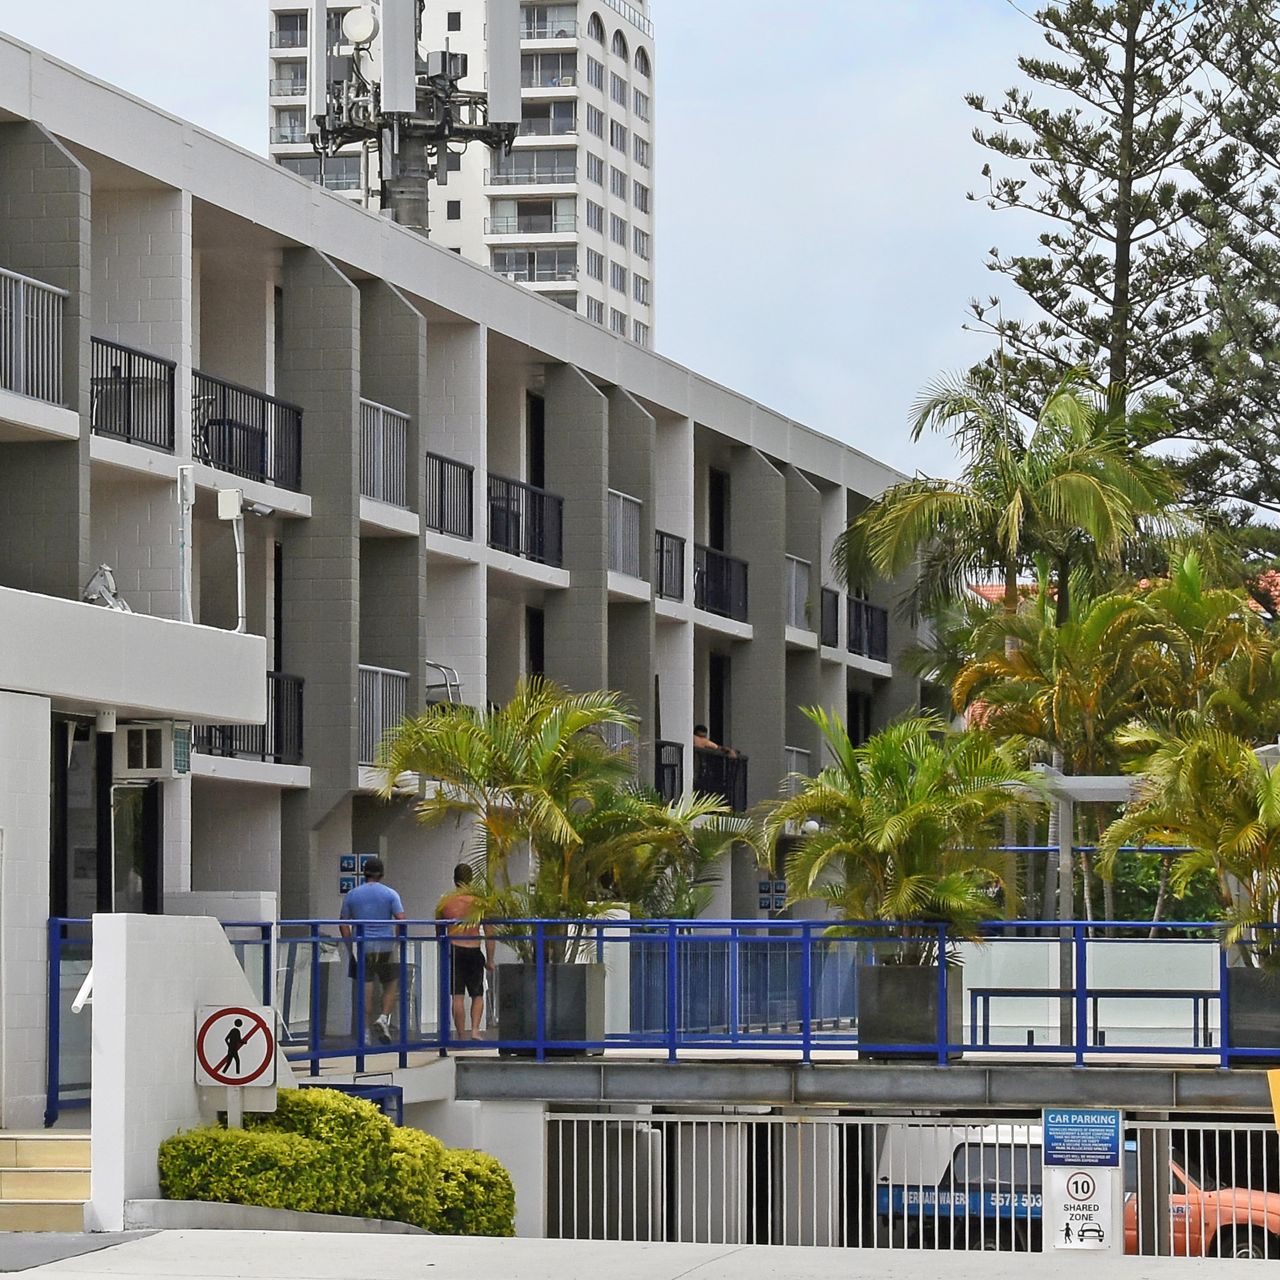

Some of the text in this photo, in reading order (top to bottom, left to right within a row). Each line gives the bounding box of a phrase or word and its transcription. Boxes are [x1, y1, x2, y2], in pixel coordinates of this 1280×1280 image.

[341, 860, 354, 869] 43
[341, 881, 354, 890] 23
[1048, 1114, 1116, 1124] CAR PARKING
[1072, 1180, 1090, 1195] 10
[1063, 1204, 1100, 1212] SHARED
[1069, 1213, 1094, 1221] ZONE
